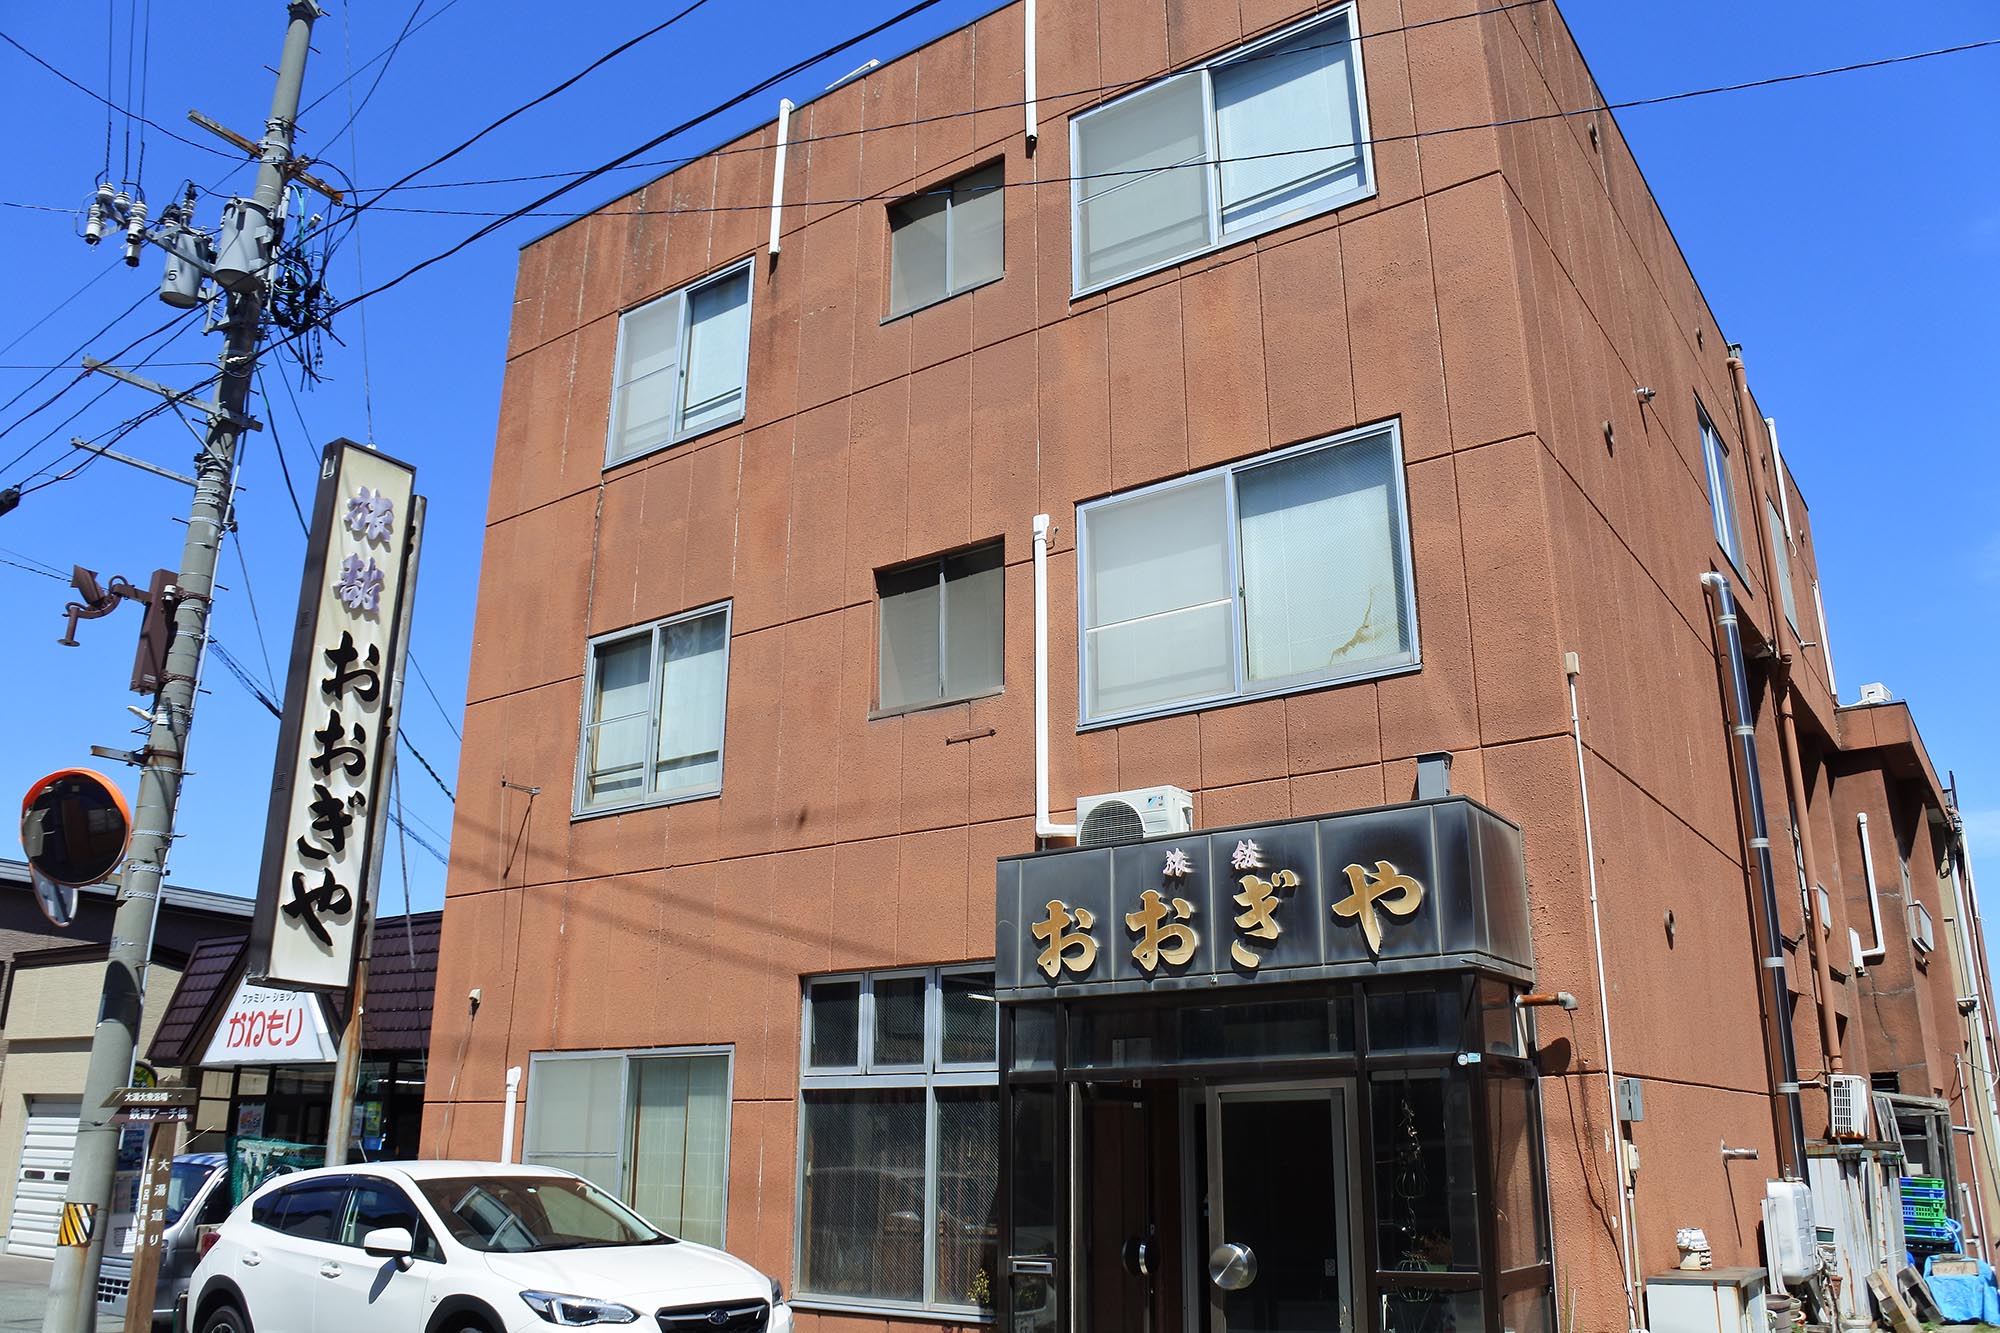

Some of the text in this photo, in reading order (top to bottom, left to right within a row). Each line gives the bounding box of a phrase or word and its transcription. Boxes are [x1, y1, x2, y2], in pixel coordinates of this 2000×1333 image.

[167, 269, 178, 281] 5
[280, 630, 380, 947] おおぎや
[1031, 860, 1423, 979] おおぎや
[226, 1007, 304, 1049] かねもり
[128, 1107, 189, 1120] 鉄道アーチ橋
[149, 1158, 170, 1247] 大湯通り
